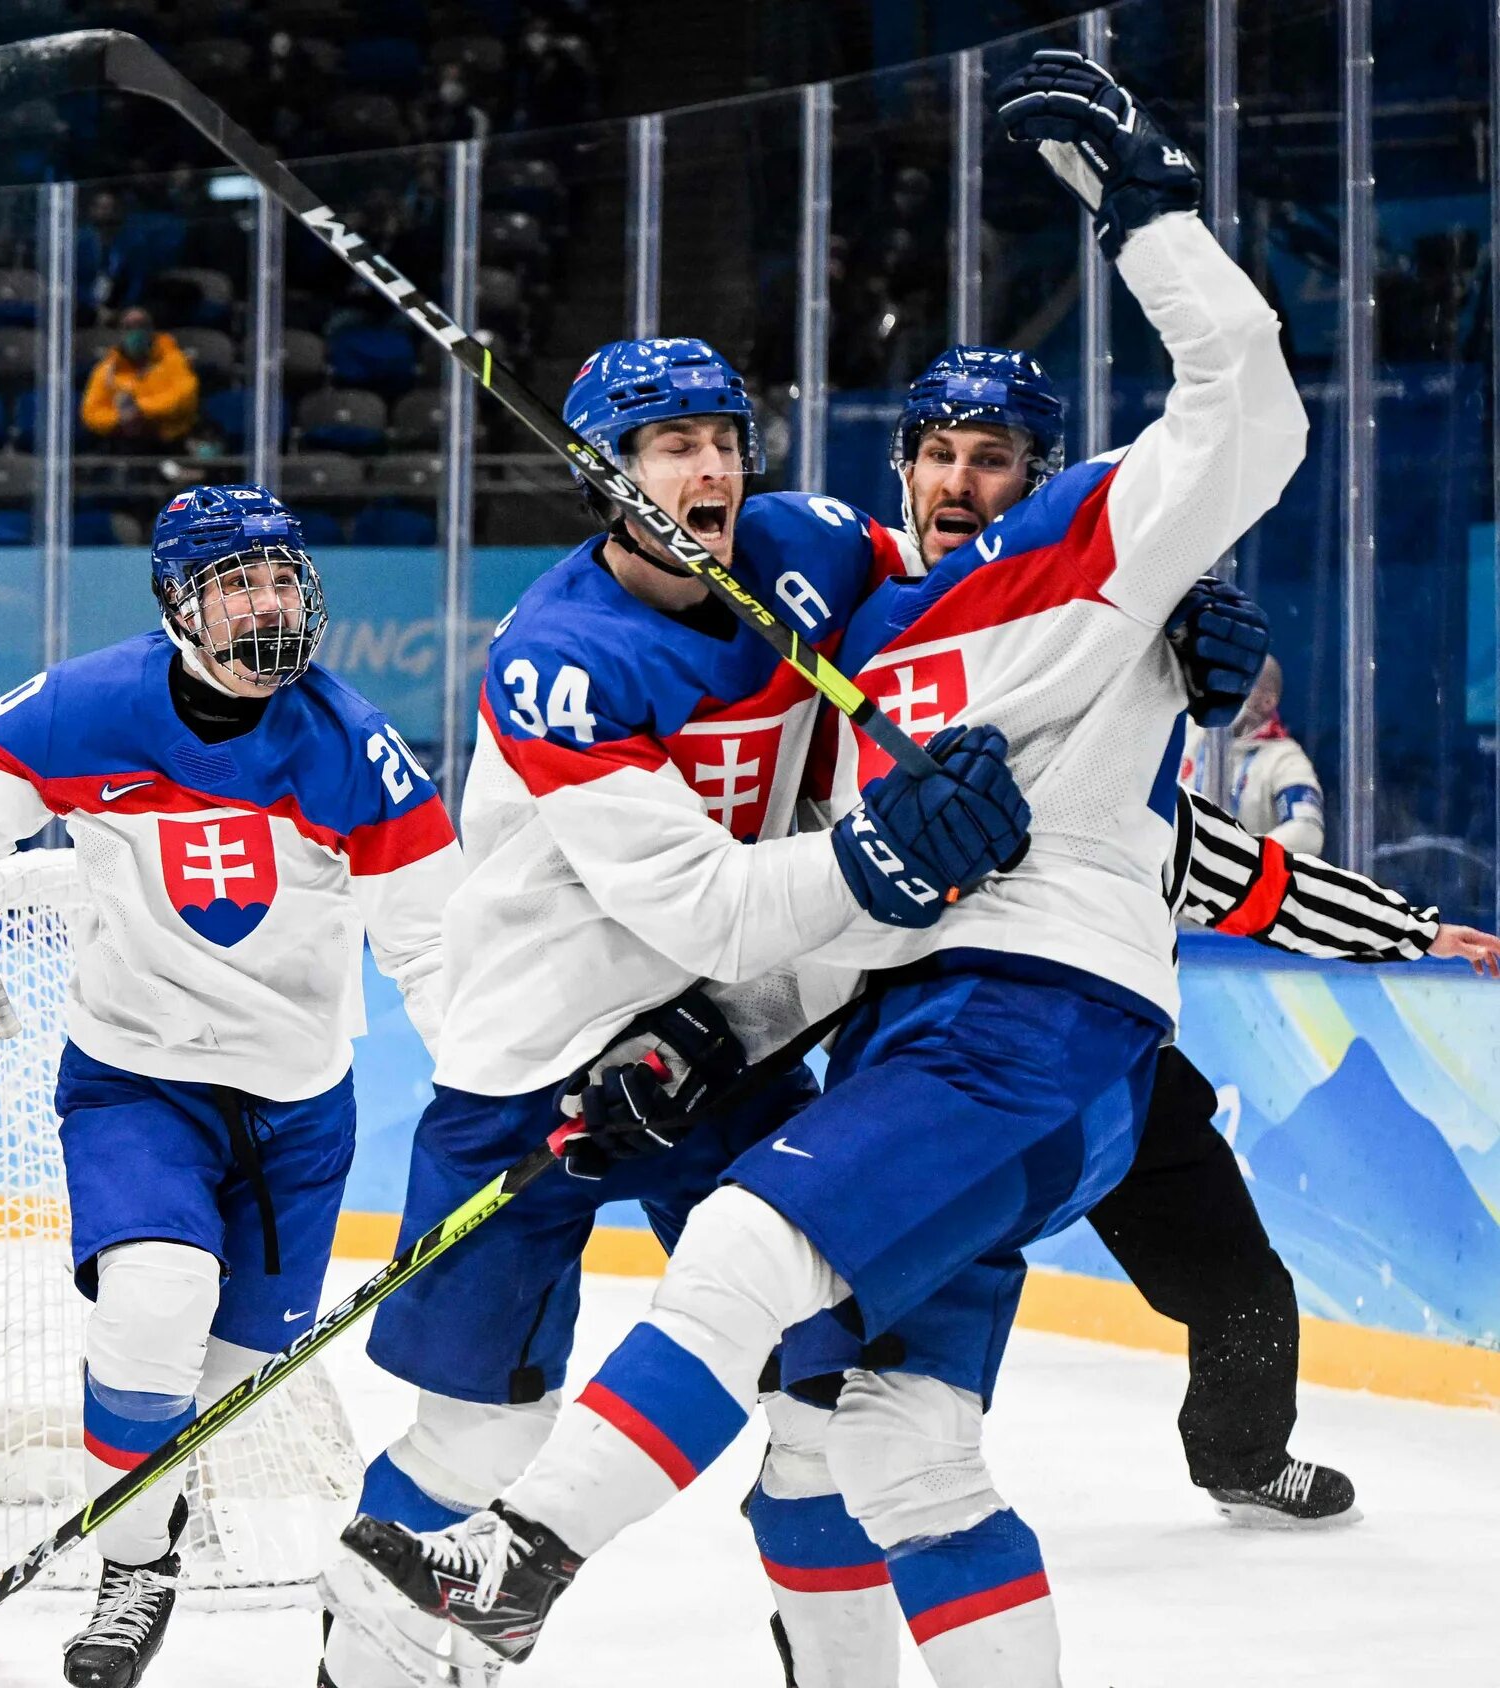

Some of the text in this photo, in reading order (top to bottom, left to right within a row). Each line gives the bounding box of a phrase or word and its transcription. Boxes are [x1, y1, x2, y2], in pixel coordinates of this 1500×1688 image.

[300, 205, 468, 350] CCM
[604, 473, 711, 574] TACKS
[707, 564, 776, 626] SUPER
[775, 571, 832, 629] A
[503, 659, 597, 743] 34
[851, 801, 939, 907] CCM
[676, 1006, 710, 1034] BAUER
[453, 1200, 499, 1240] CCM
[176, 1384, 247, 1446] SUPER
[251, 1292, 359, 1393] TACKS
